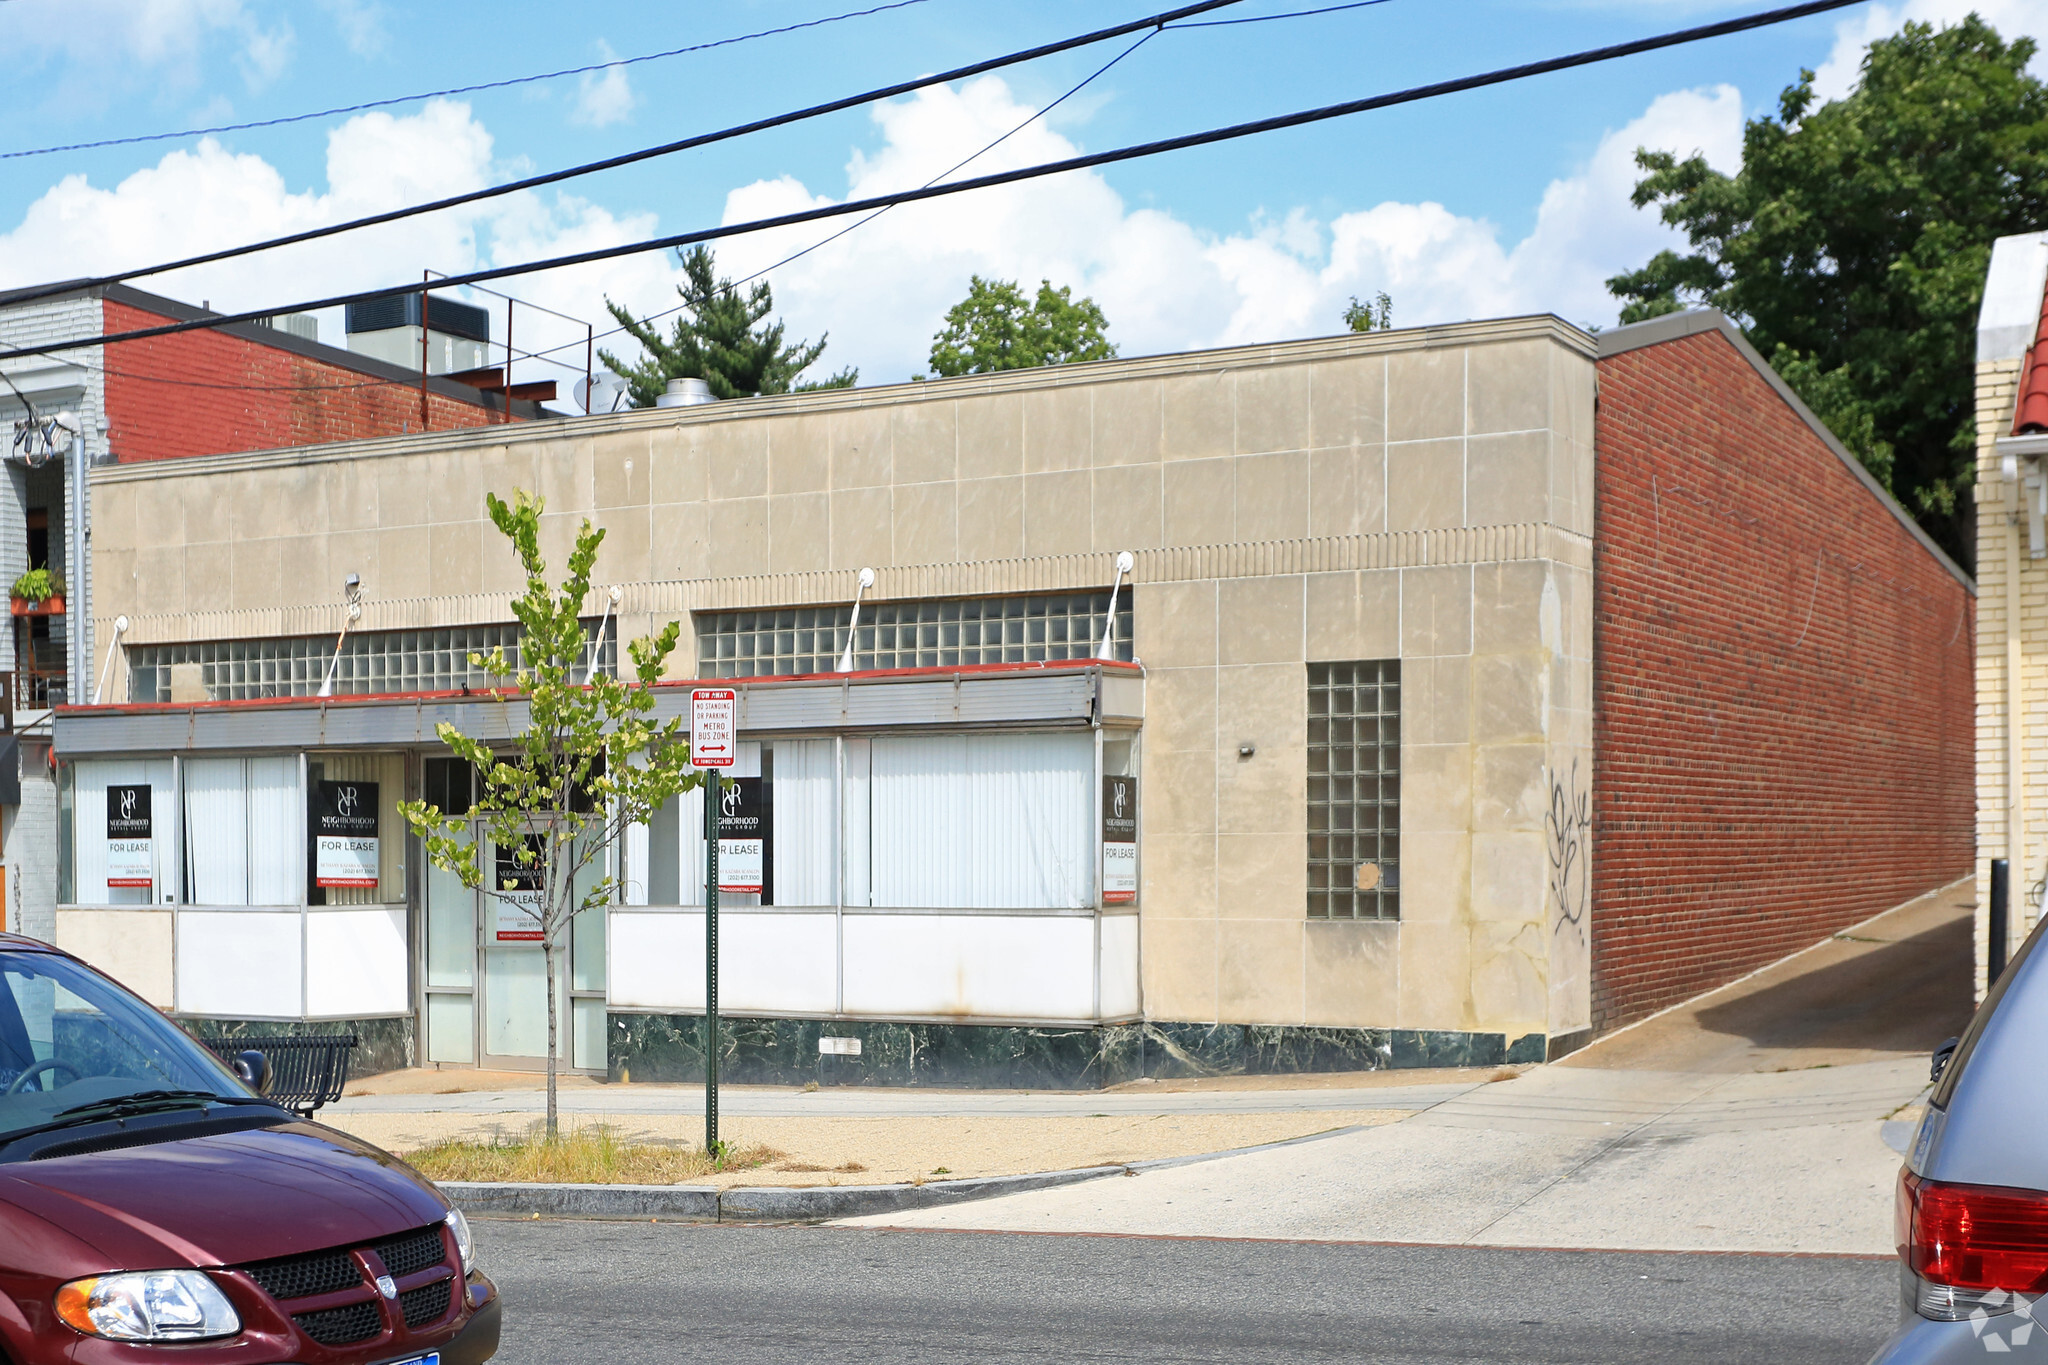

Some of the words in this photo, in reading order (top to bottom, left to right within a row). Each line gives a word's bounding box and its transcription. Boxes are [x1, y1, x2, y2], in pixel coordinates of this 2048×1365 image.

[696, 702, 703, 710] NO
[705, 702, 730, 710] STANDING
[703, 722, 725, 730] METRO
[698, 732, 710, 740] BUS
[712, 732, 729, 740] ZONE
[321, 816, 375, 824] NEIGHBORHOOD
[718, 817, 759, 825] GHBORHOOD
[110, 843, 125, 852] FOR
[126, 843, 149, 852] LEASE
[321, 841, 342, 850] FOR
[344, 842, 375, 851] LEASE
[729, 845, 759, 855] LEASE
[1105, 848, 1118, 858] FOR
[1118, 848, 1135, 859] LEASE
[499, 895, 516, 904] FOR
[518, 895, 543, 904] LEASE
